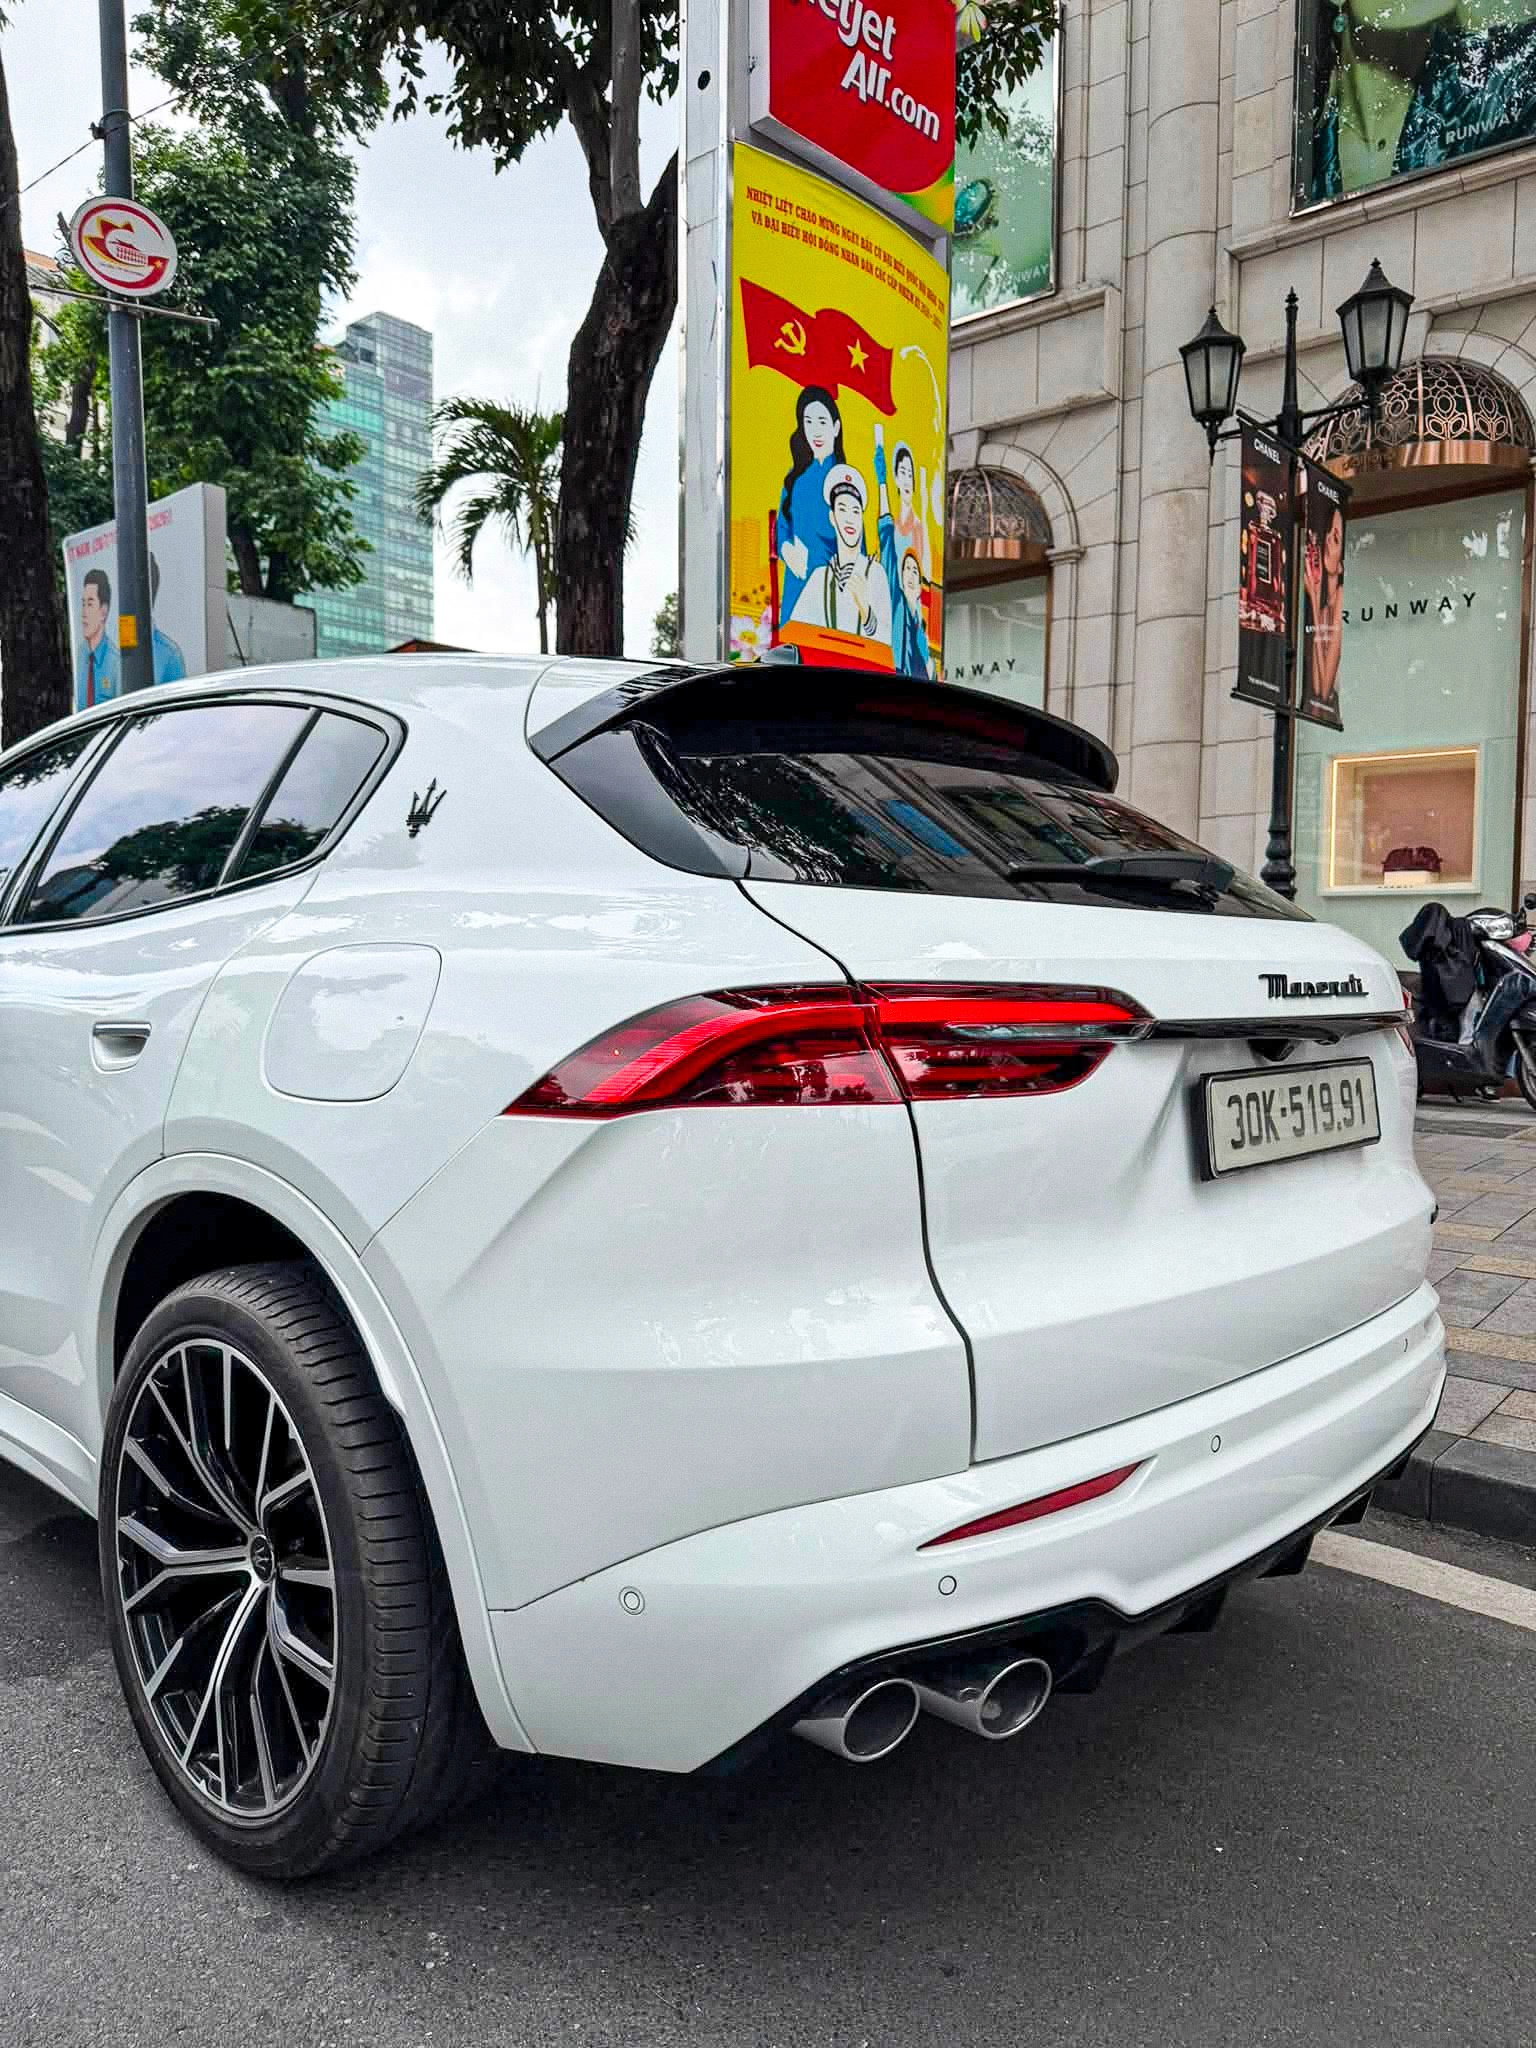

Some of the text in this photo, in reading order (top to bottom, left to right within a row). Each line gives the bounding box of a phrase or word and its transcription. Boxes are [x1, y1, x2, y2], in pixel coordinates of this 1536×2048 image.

[1446, 107, 1522, 145] RUNWAY
[1253, 438, 1281, 465] CHANEL
[1258, 973, 1370, 999] Maserati
[1227, 1077, 1367, 1150] 30K-519.91
